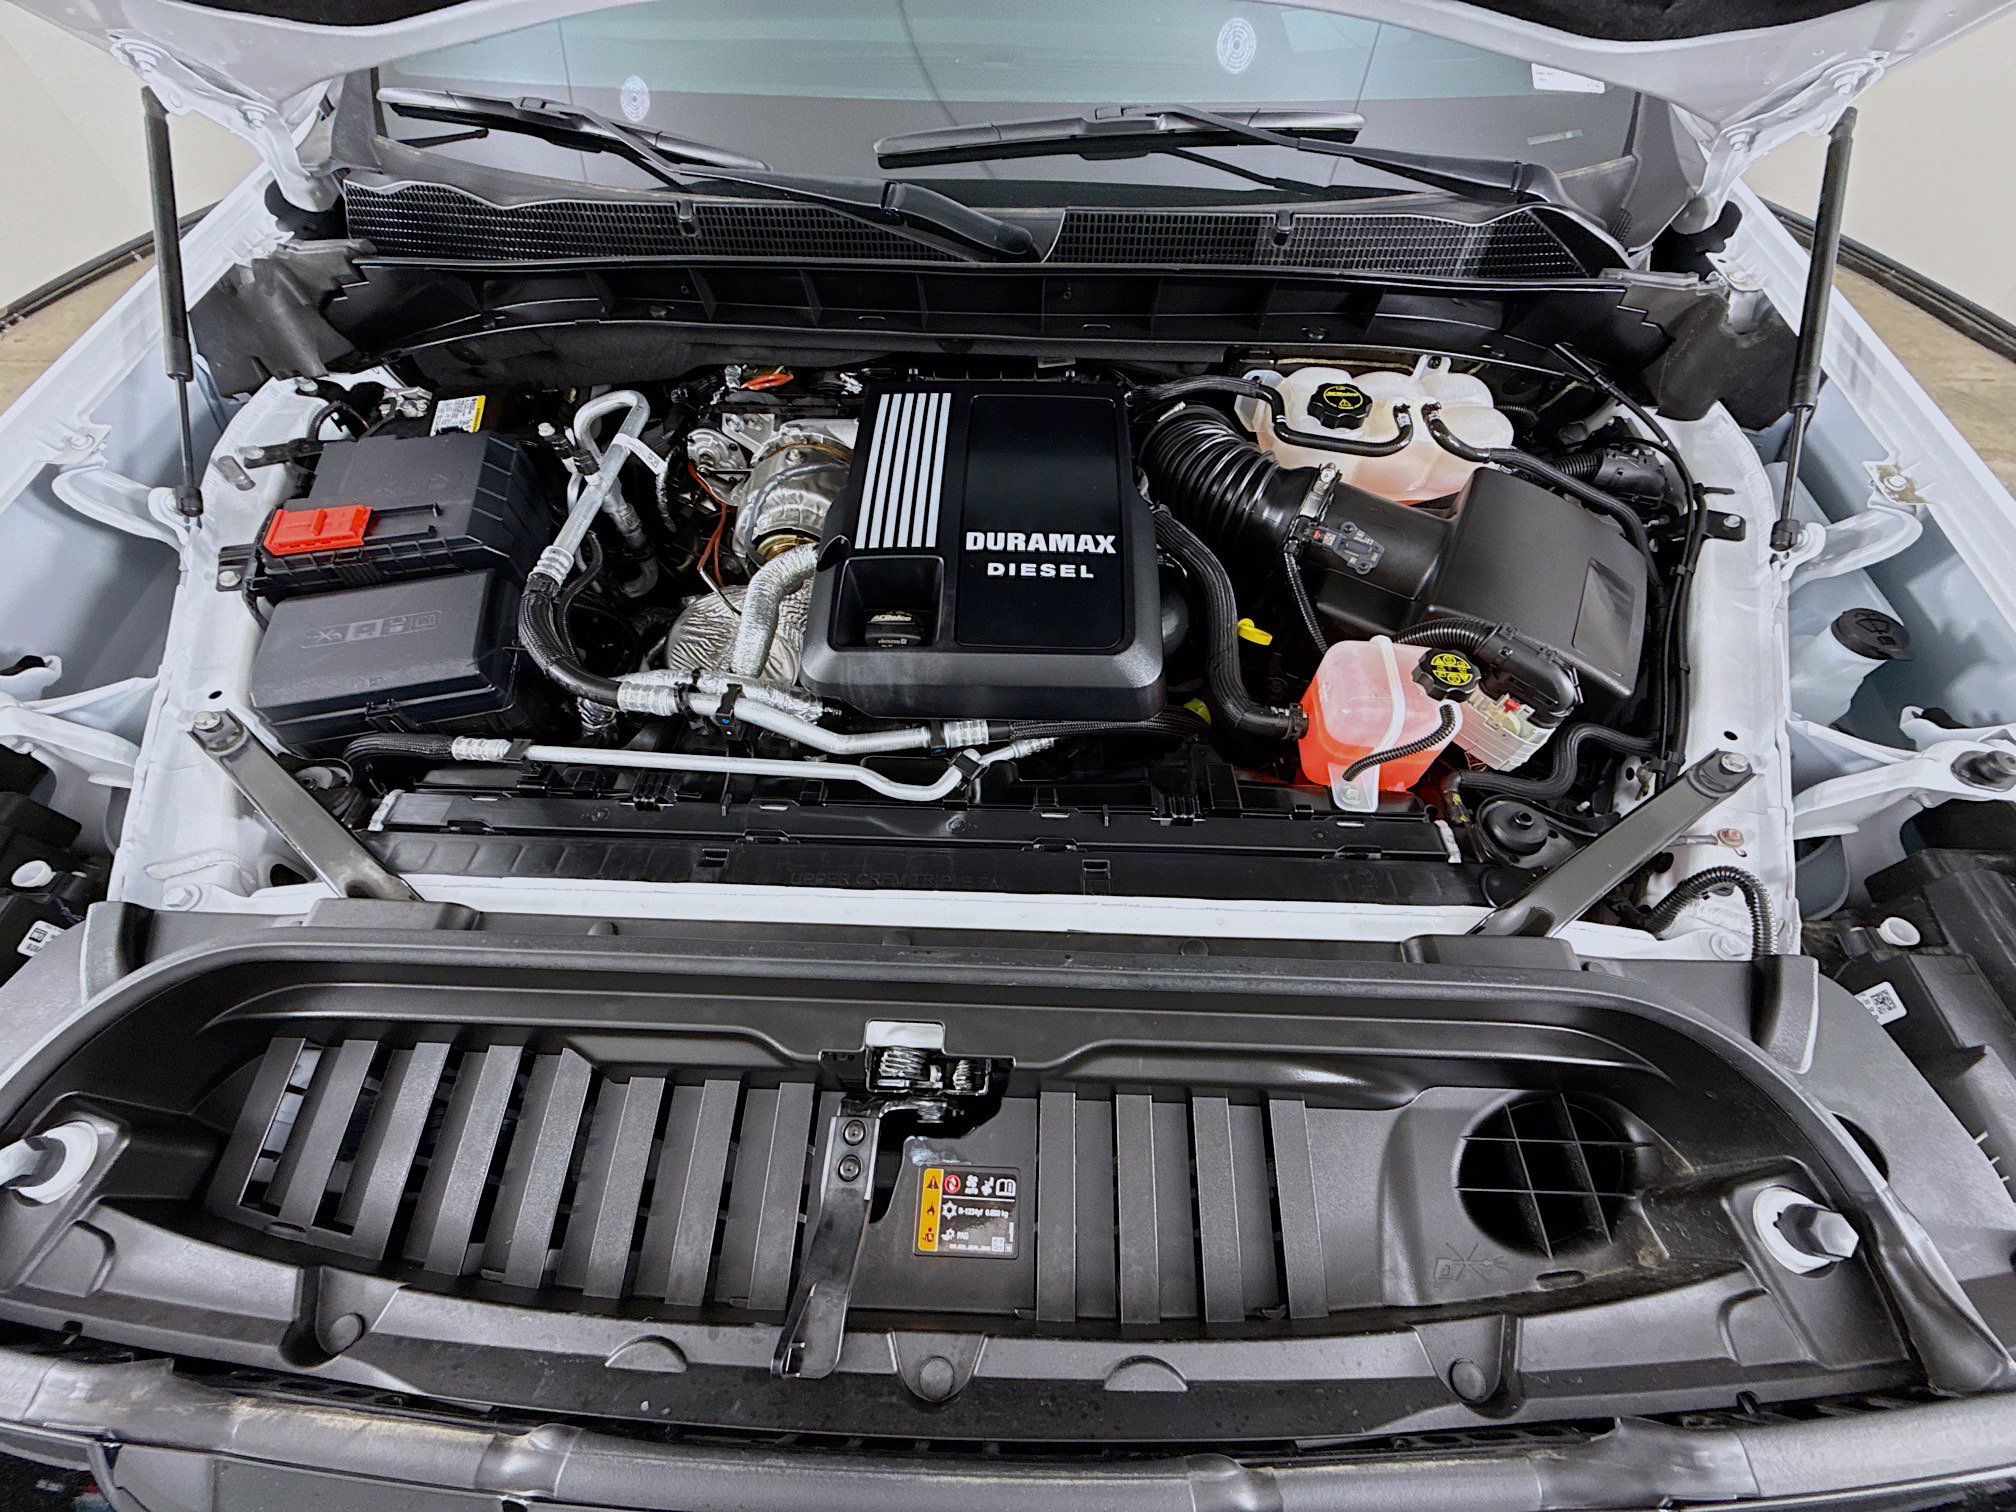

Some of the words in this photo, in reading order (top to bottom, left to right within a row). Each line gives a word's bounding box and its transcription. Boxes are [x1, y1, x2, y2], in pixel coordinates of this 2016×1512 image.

[965, 531, 1116, 554] DURAMAX
[987, 563, 1094, 578] DIESEL
[870, 614, 912, 622] ACDelco
[957, 1231, 969, 1240] PAG
